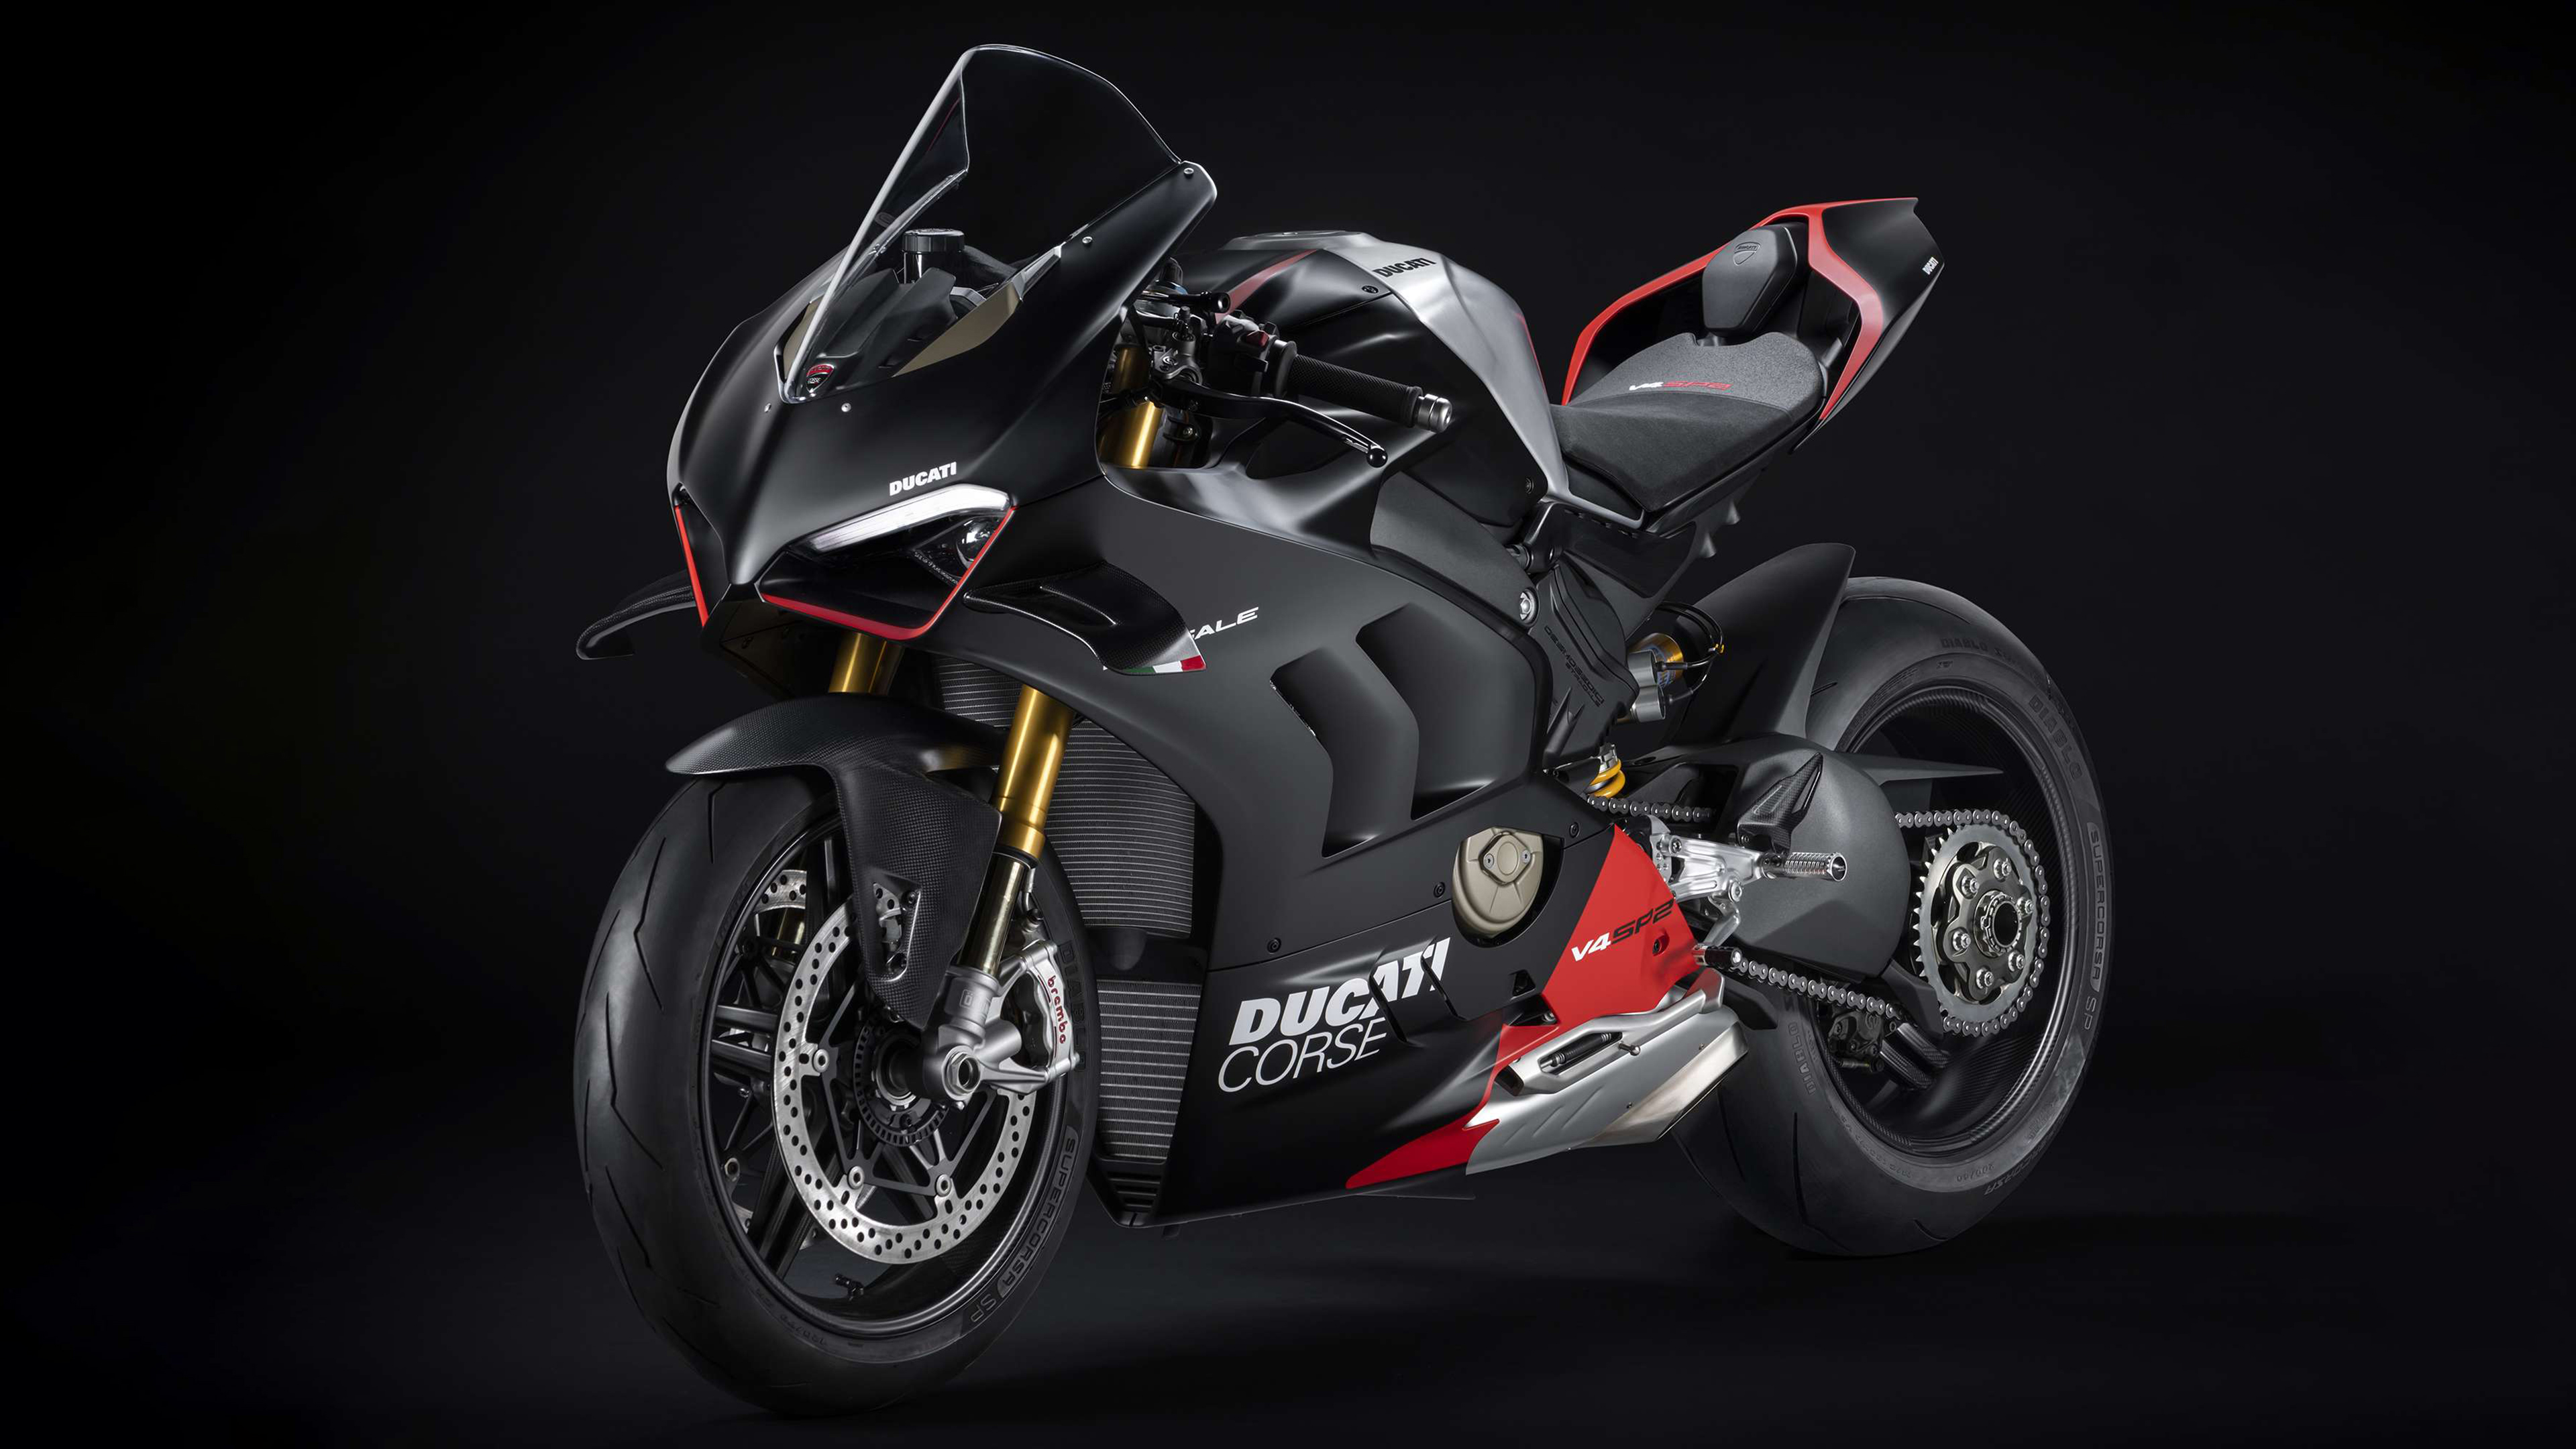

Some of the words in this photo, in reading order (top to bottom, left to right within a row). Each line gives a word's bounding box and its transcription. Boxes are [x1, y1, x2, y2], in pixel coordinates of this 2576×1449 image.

[1373, 258, 1436, 278] DUCATI
[890, 462, 957, 496] DUCATI
[1189, 606, 1258, 640] ALE
[2029, 694, 2082, 781] DIABLO
[2090, 829, 2106, 981] SUPERCORSA
[1048, 975, 1069, 1044] brembo
[1228, 937, 1451, 1046] DUCATI
[2084, 997, 2096, 1031] SP
[1218, 1017, 1387, 1093] CORSE
[1006, 1137, 1075, 1286] SUPERCORSA
[970, 1293, 997, 1323] SP
